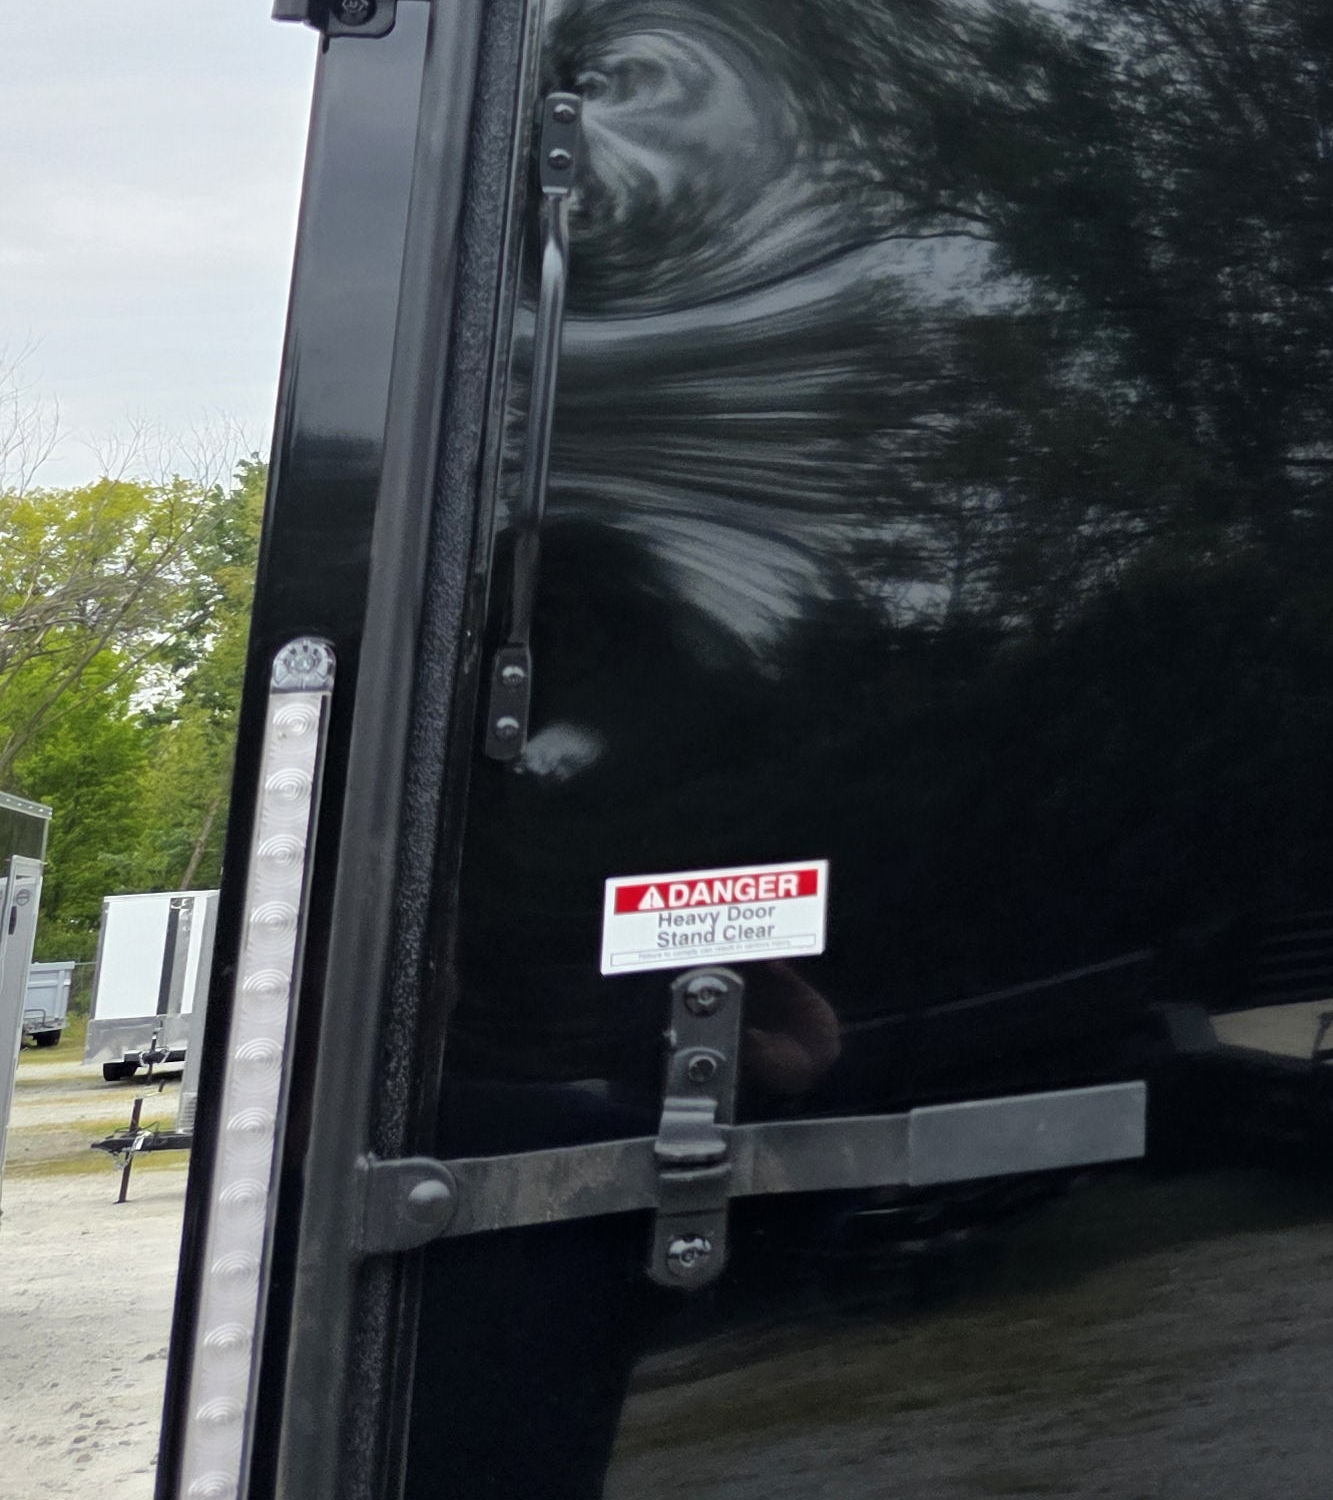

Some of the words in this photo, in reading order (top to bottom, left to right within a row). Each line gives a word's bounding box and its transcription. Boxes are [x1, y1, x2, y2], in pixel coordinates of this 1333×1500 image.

[668, 873, 799, 908] DANGER
[658, 909, 720, 930] Heavy
[727, 904, 775, 923] Door
[656, 924, 715, 949] Stand
[722, 923, 775, 941] Clear
